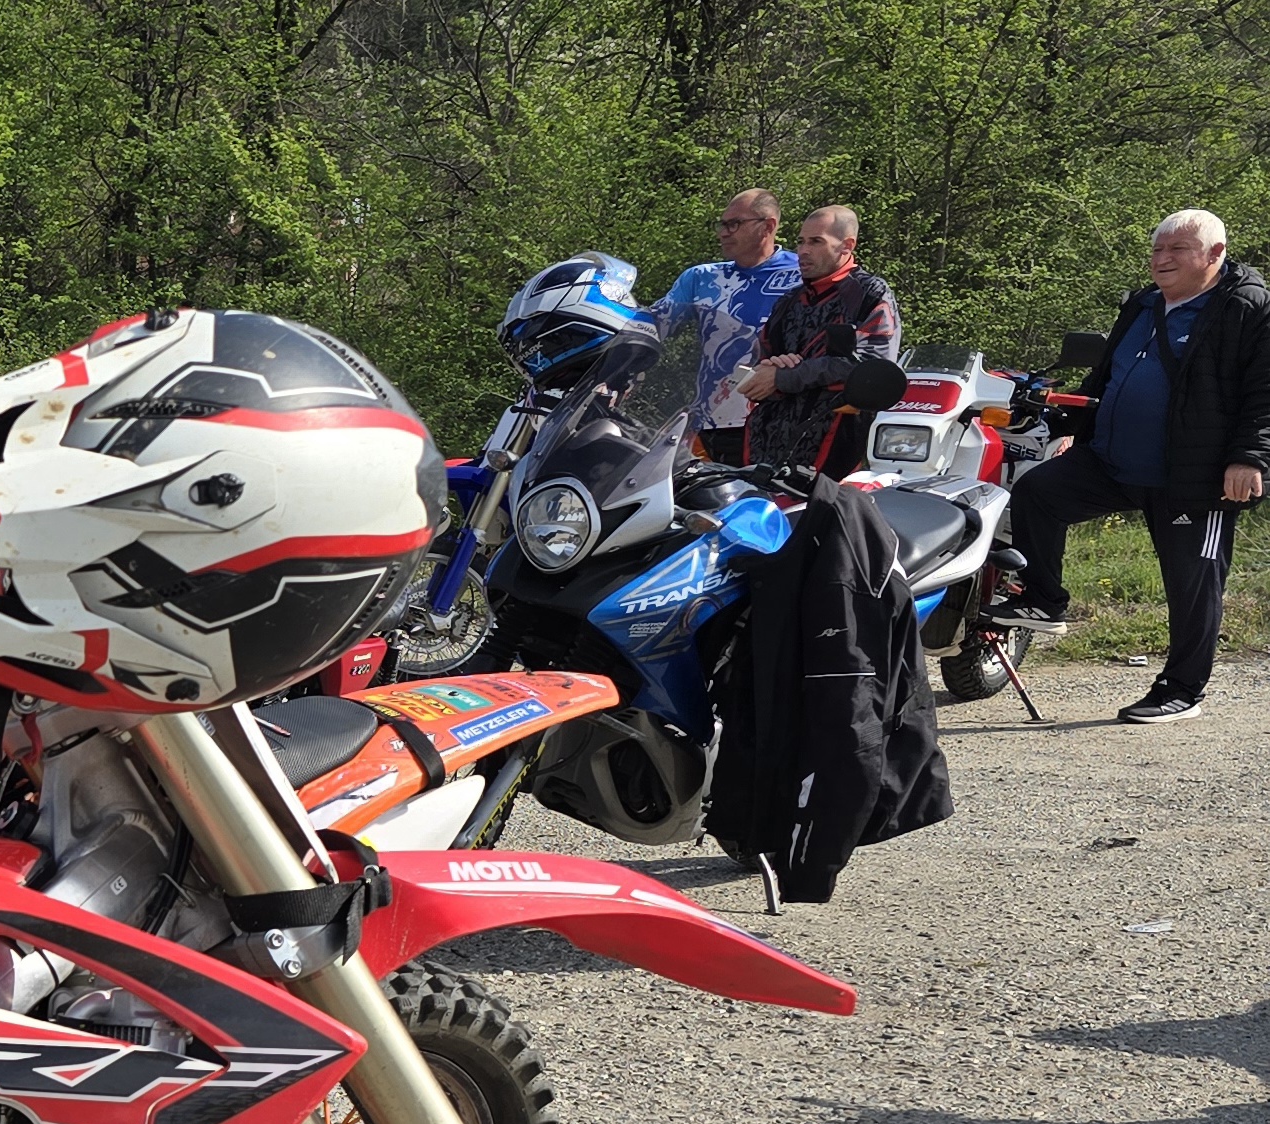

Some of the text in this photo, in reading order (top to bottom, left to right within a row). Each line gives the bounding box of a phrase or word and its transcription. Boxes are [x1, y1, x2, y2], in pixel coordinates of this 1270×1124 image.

[888, 400, 943, 413] DAKAR
[457, 707, 530, 742] METZELER
[448, 860, 552, 884] MOTUL
